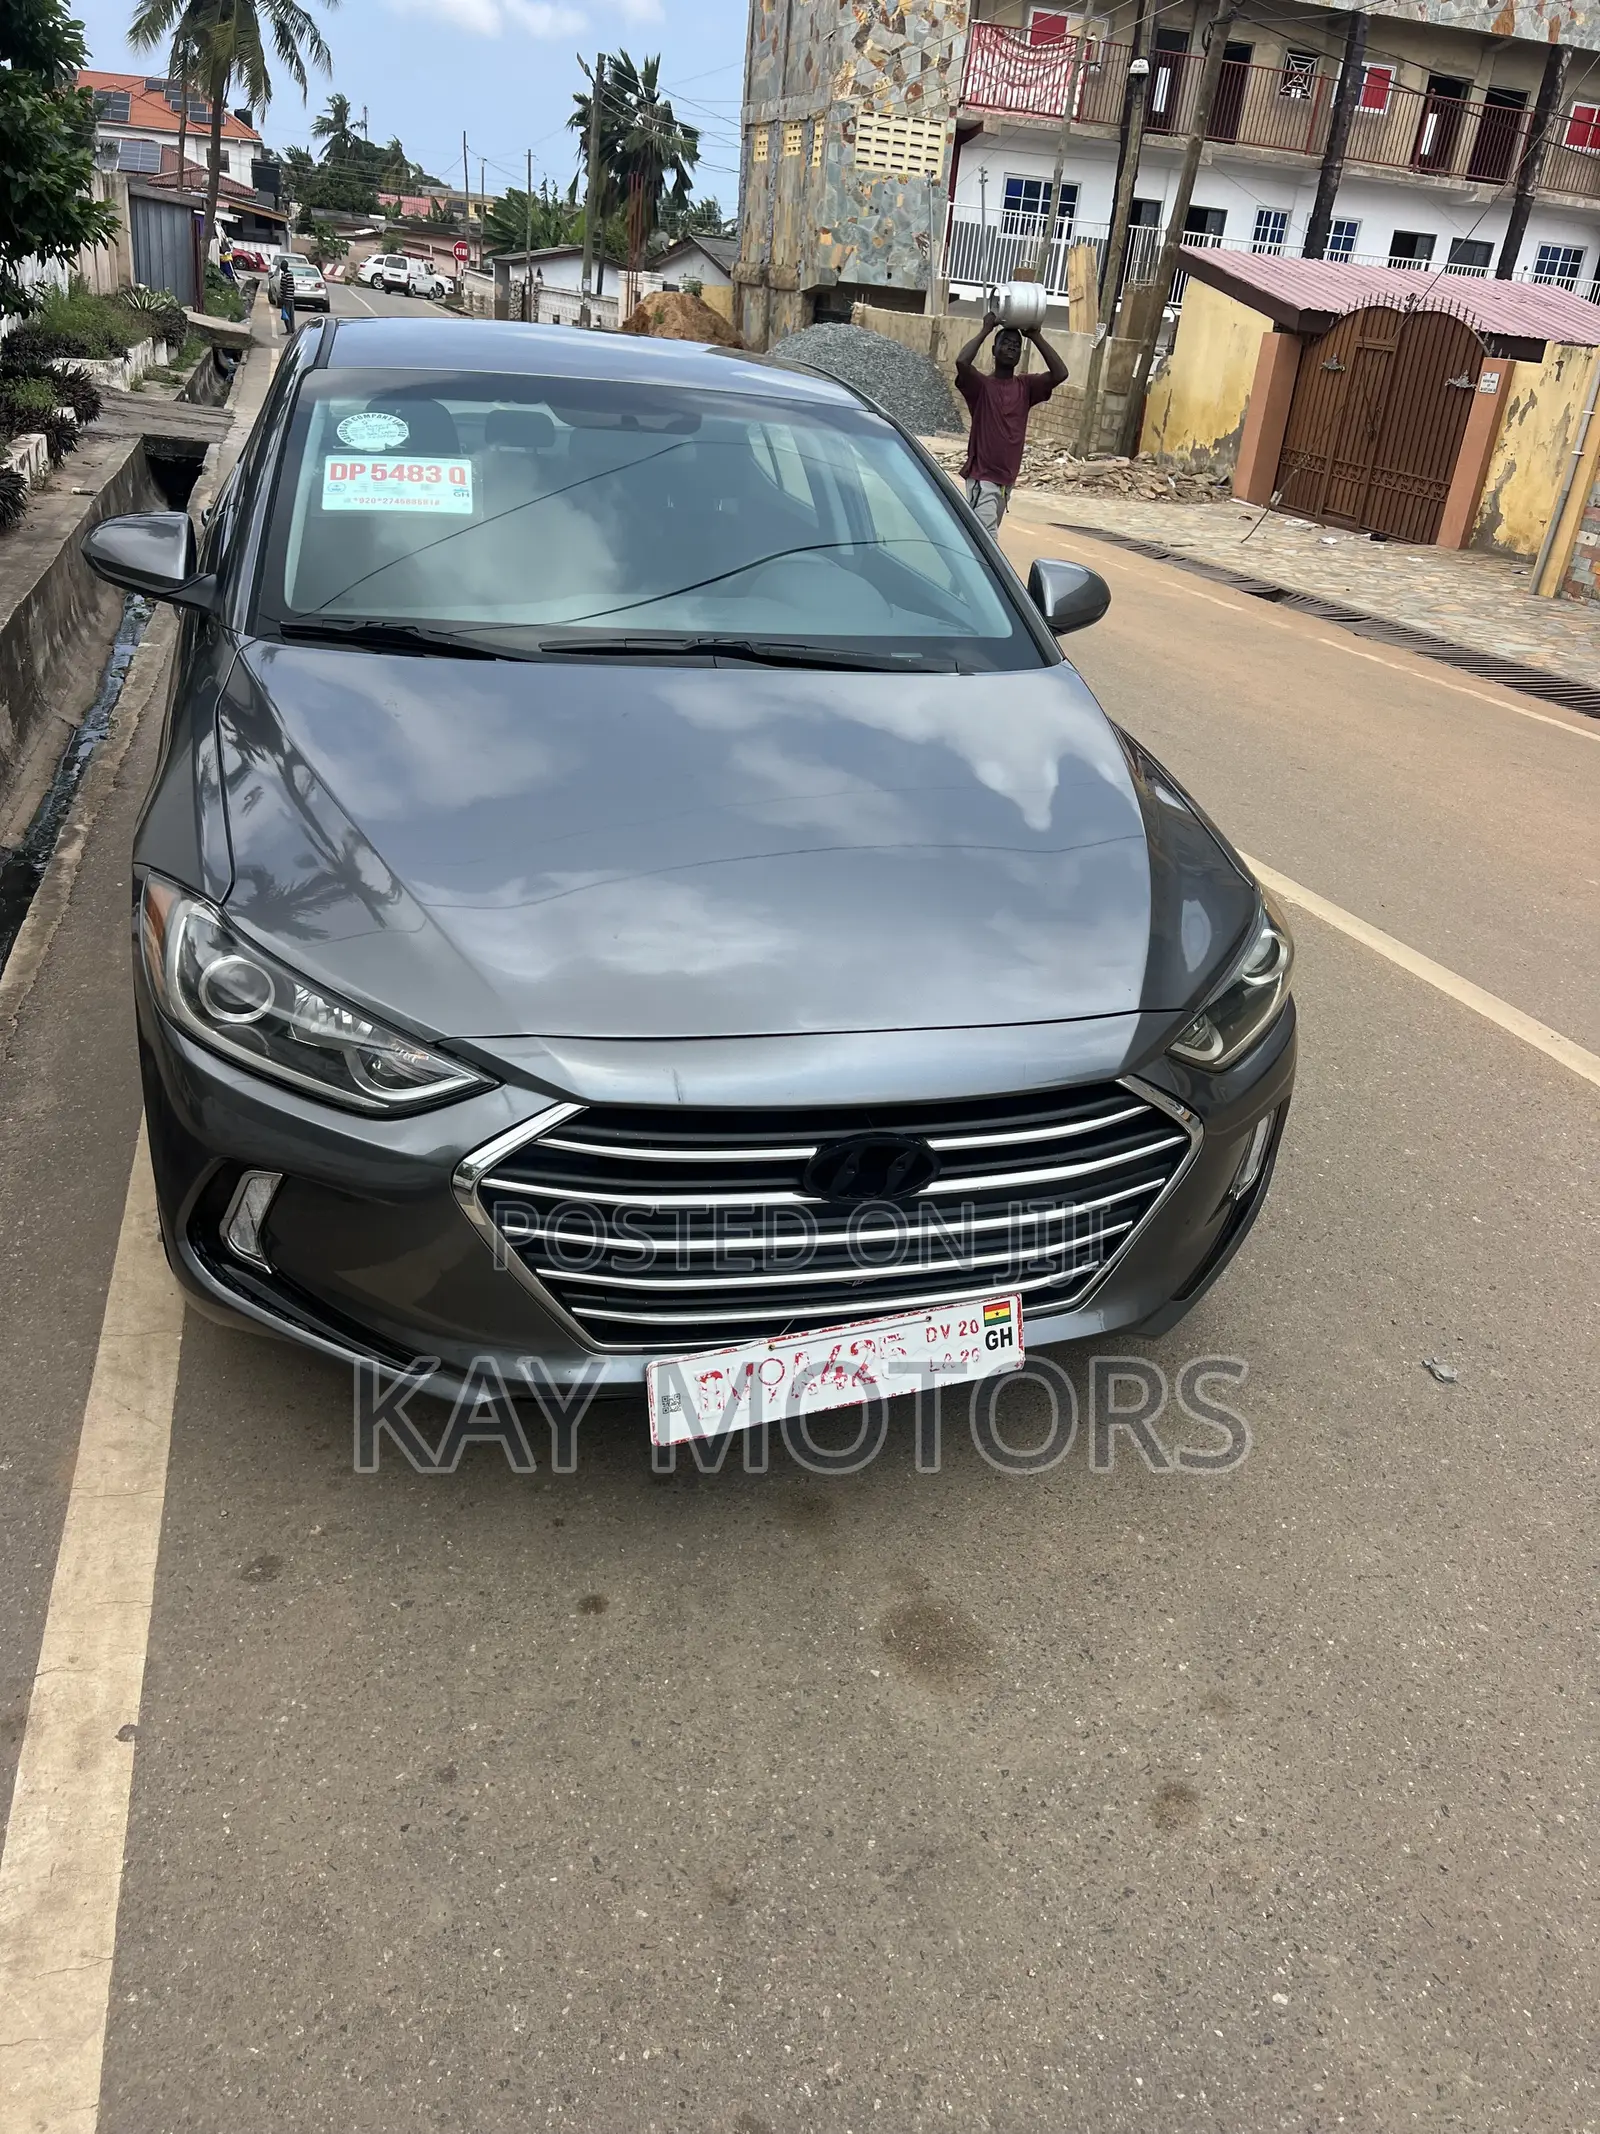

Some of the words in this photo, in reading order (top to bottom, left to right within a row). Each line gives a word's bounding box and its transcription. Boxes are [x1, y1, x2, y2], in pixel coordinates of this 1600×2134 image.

[351, 413, 394, 422] COMPANY
[330, 463, 366, 481] DP
[371, 463, 442, 483] 5483
[448, 466, 467, 486] Q
[925, 1323, 951, 1343] DV
[958, 1319, 980, 1337] 20
[985, 1326, 1013, 1351] GH
